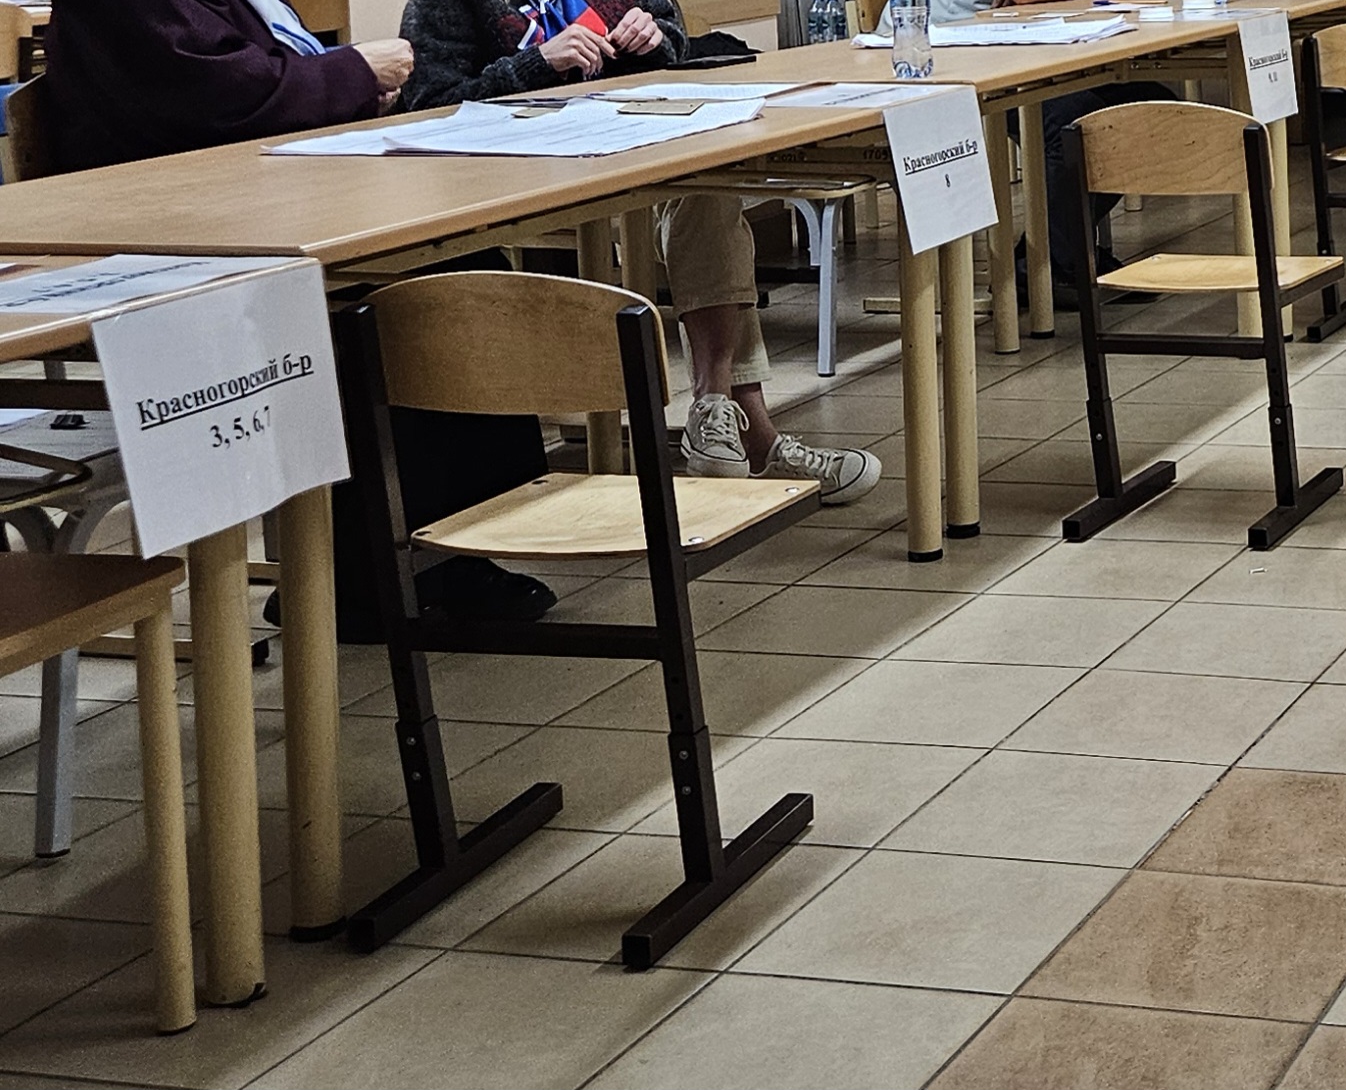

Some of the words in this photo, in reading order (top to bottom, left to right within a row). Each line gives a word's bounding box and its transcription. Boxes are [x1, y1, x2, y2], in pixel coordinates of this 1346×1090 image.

[903, 141, 964, 172] Красногорский
[965, 139, 978, 153] б-р
[944, 173, 951, 188] 8
[135, 358, 279, 425] Красногорский
[282, 353, 312, 376] б-р
[210, 424, 231, 449] 3,
[233, 416, 251, 441] 5,
